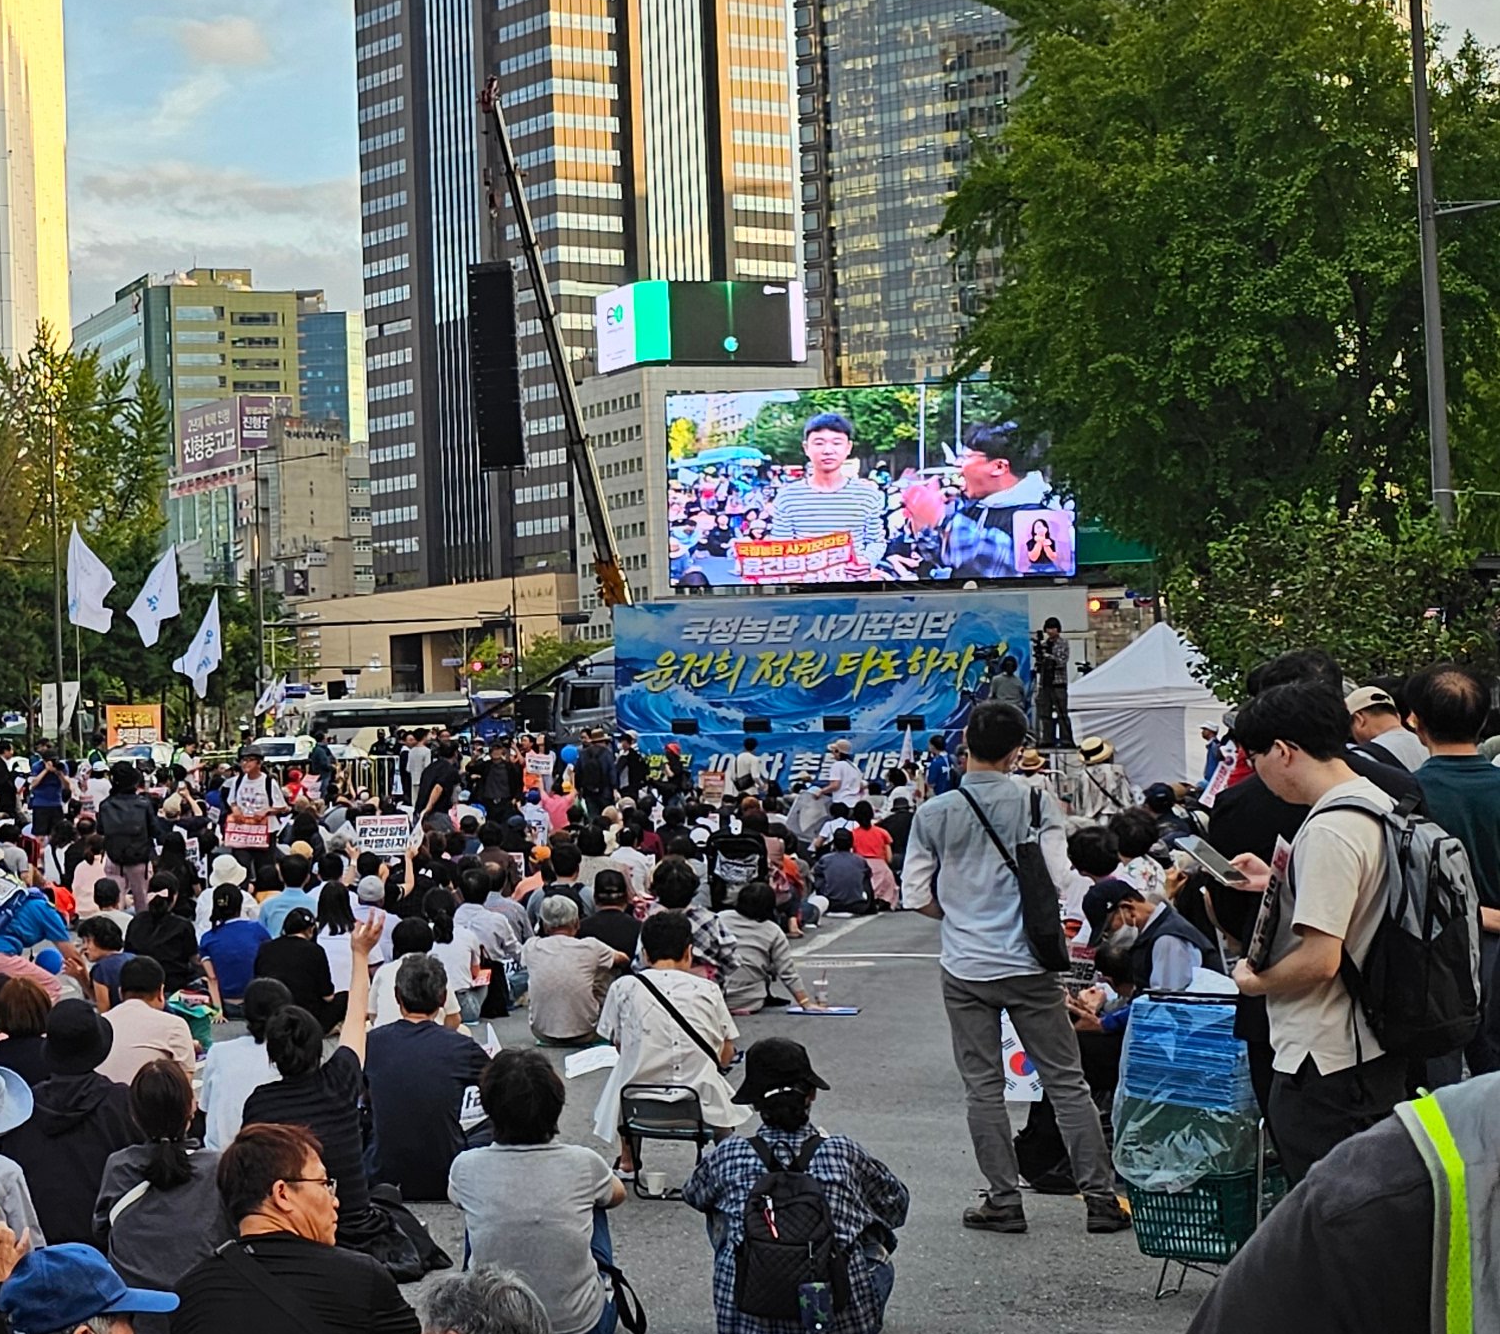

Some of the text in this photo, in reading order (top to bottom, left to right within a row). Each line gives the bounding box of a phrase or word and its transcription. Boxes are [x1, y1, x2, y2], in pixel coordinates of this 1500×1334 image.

[183, 428, 236, 464] 진형중고교
[680, 610, 957, 644] 국정농단 사기꾼집단
[633, 647, 748, 694] 윤건희
[749, 648, 833, 690] 정권
